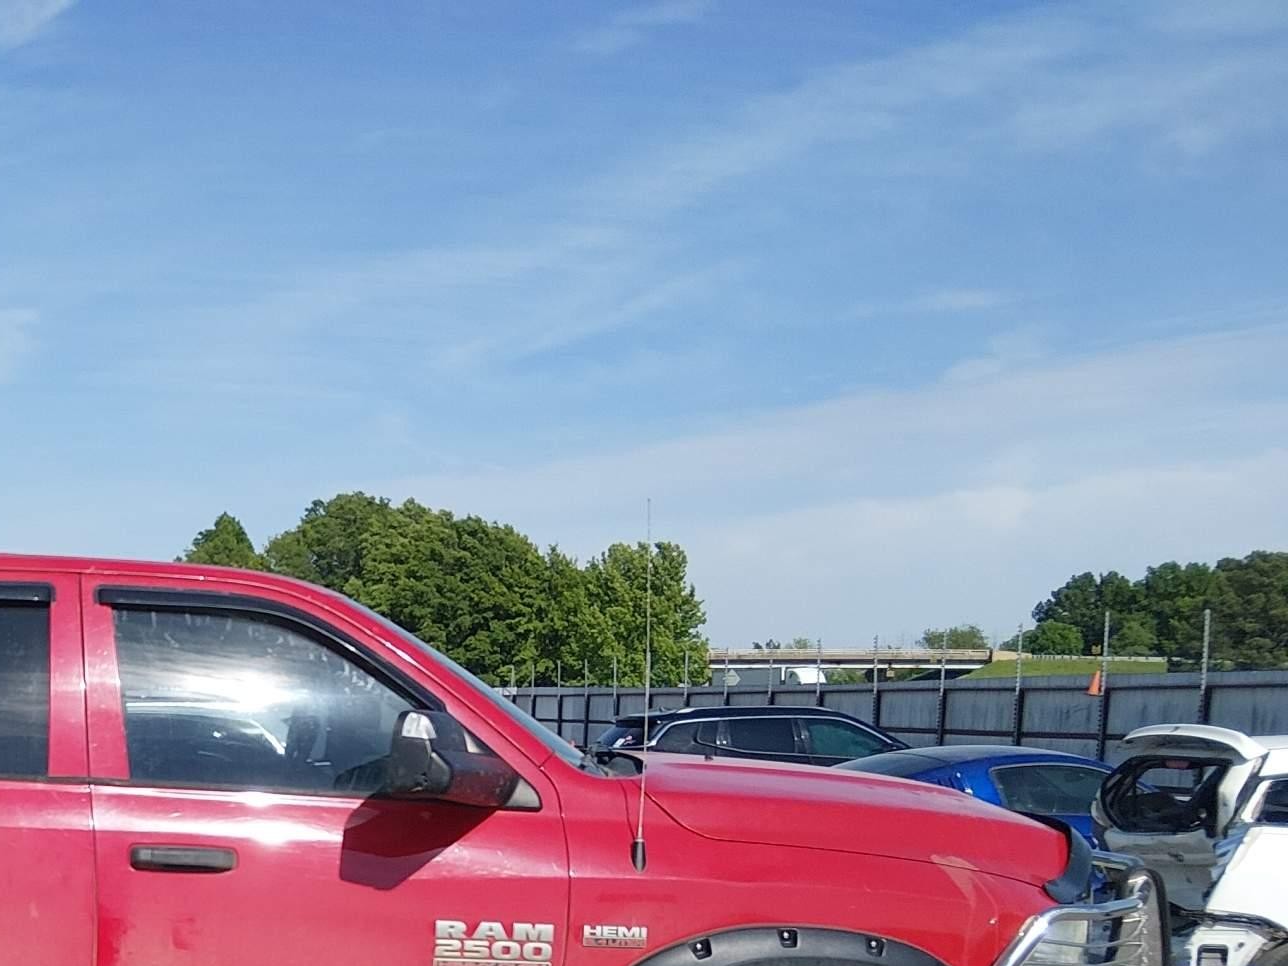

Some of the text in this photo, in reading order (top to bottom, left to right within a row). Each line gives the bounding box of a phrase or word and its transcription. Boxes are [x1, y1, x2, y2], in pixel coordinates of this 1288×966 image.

[434, 919, 554, 942] RAM
[583, 924, 648, 939] HEMI
[434, 939, 553, 961] 2500
